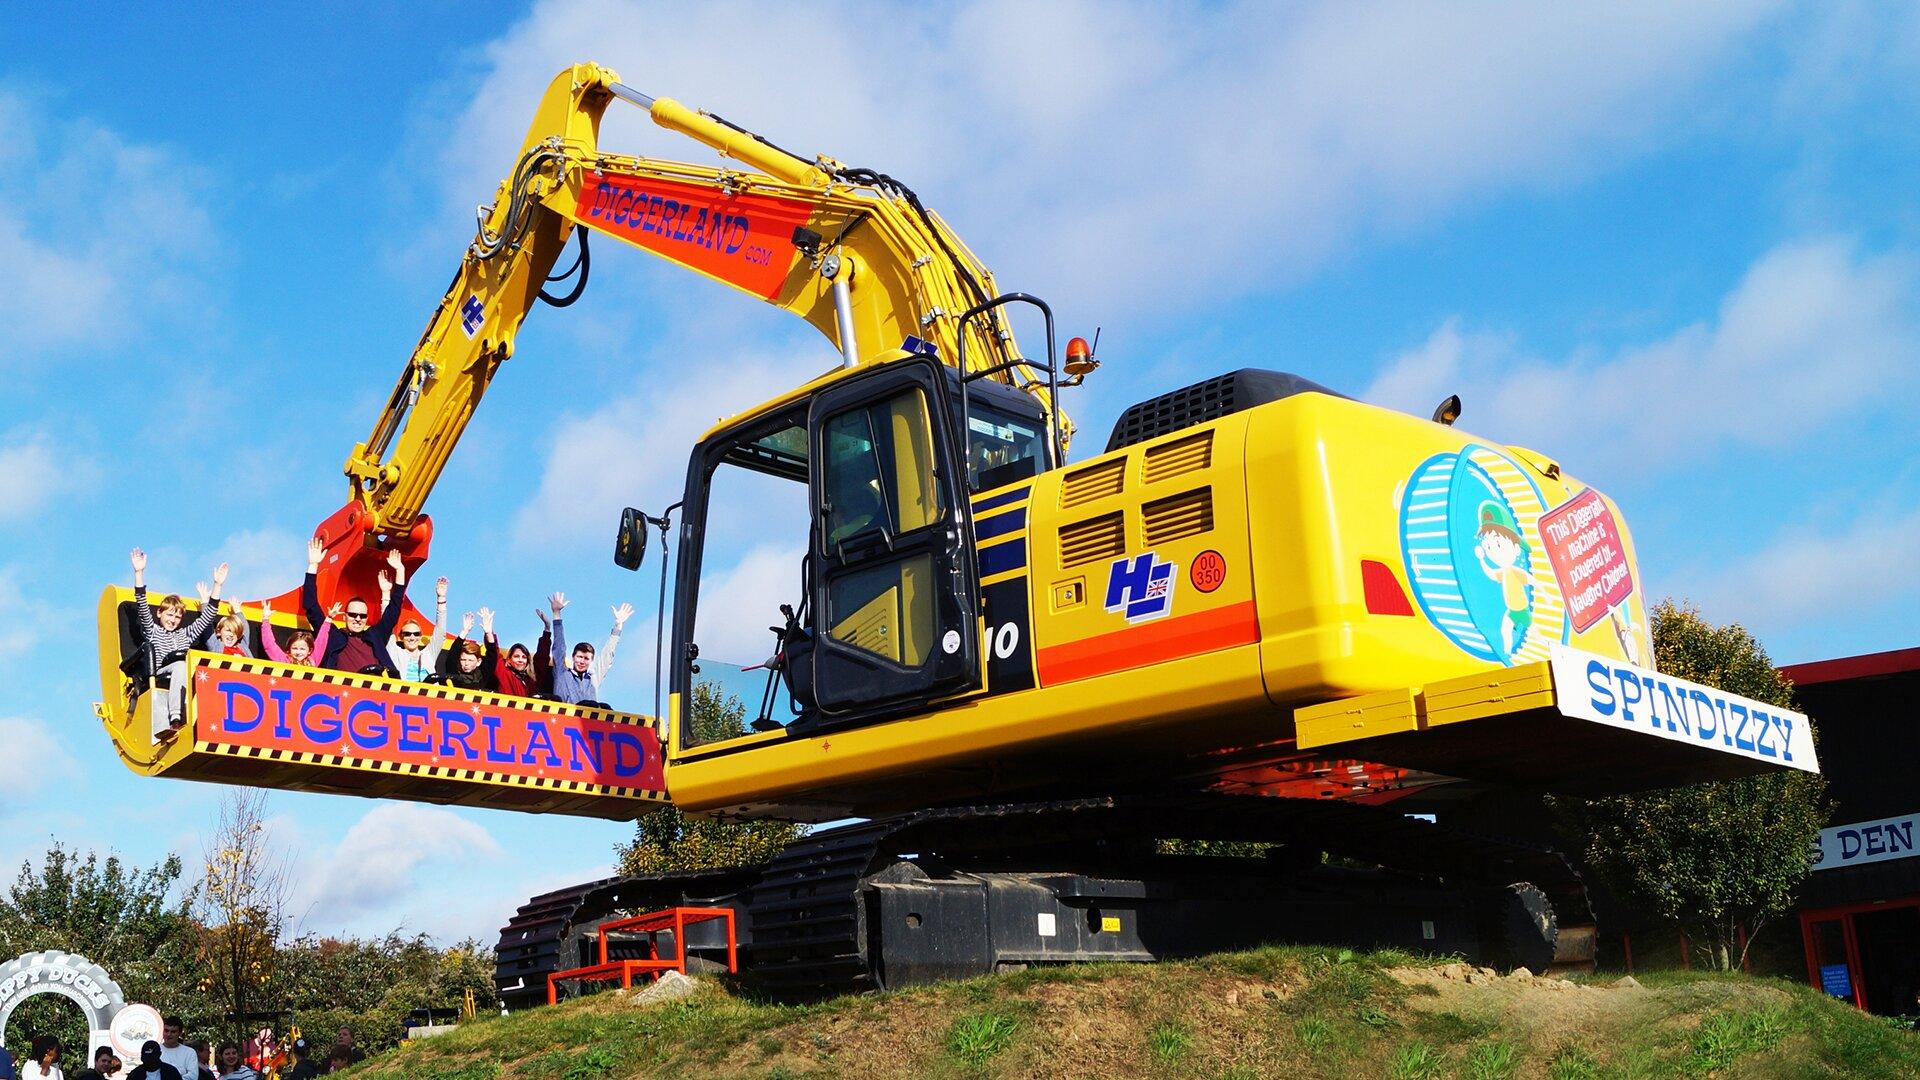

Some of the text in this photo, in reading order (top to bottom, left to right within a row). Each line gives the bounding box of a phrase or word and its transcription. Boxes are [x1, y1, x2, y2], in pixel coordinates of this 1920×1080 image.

[591, 182, 749, 254] DIGGERLAND
[1546, 518, 1570, 546] This
[1596, 520, 1607, 540] is
[1196, 568, 1221, 586] 350
[1200, 554, 1216, 571] 00
[1569, 547, 1605, 587] powered
[1568, 586, 1603, 617] Naughty
[216, 681, 647, 777] DIGGERLAND
[1586, 659, 1793, 762] SPINDIZZY
[1836, 820, 1913, 860] DEN
[48, 966, 111, 1009] DUCKS
